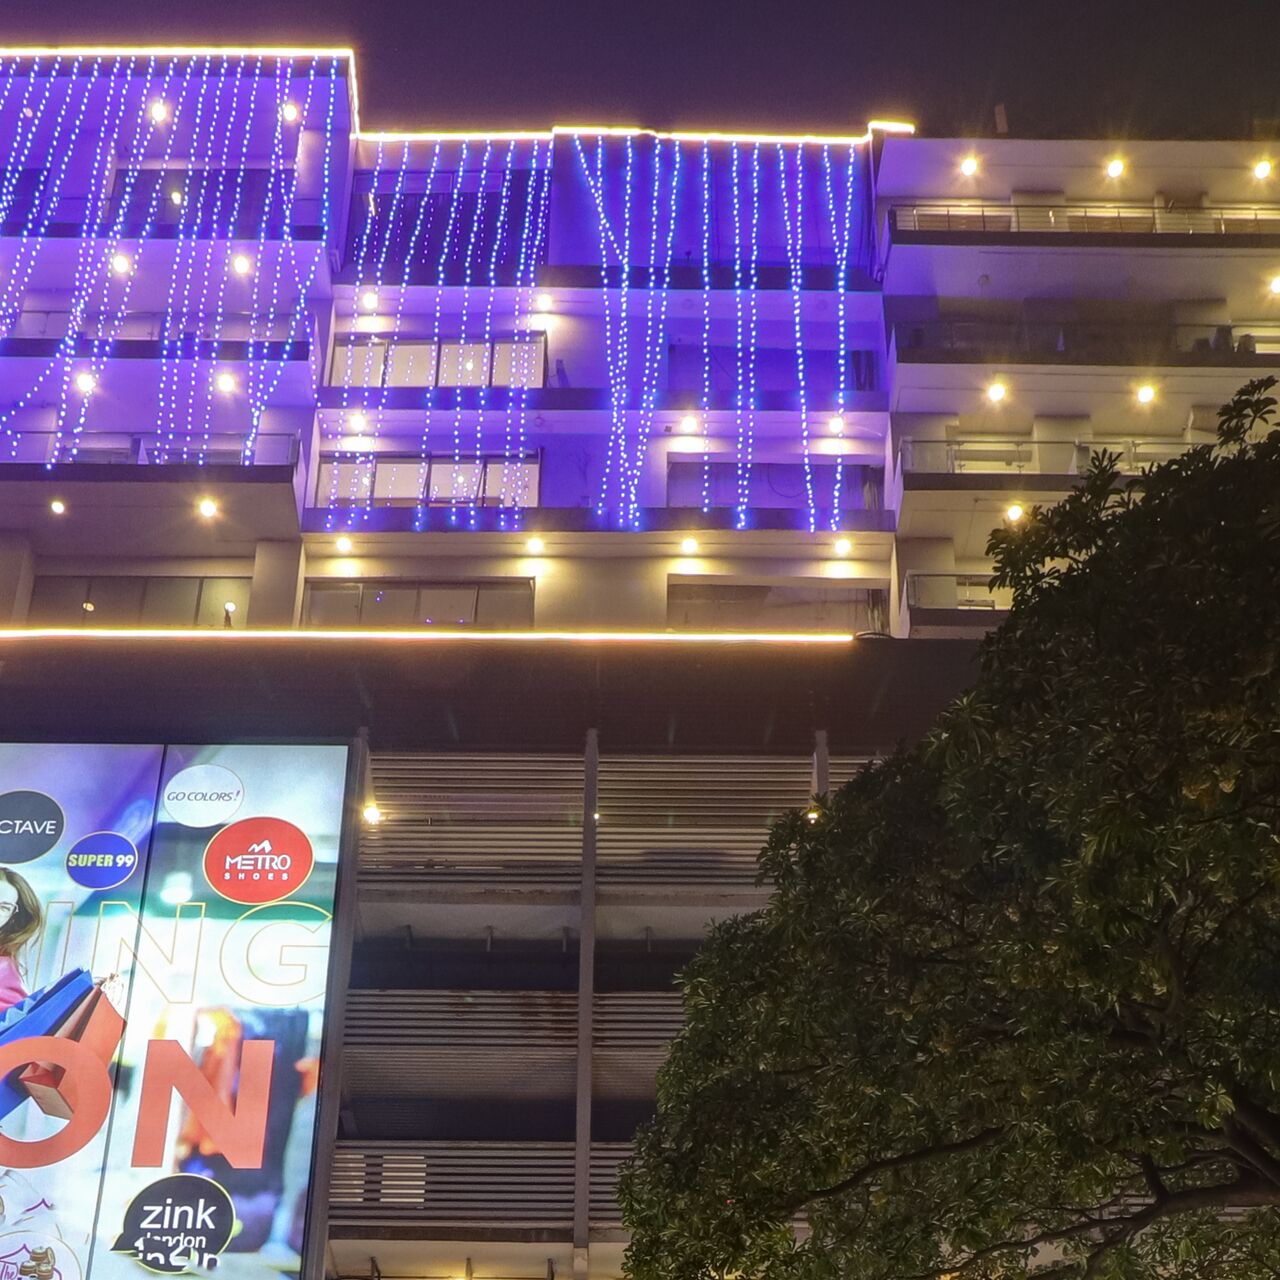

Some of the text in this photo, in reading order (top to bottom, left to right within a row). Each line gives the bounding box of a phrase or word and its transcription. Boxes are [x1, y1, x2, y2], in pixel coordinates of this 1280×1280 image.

[167, 791, 186, 802] GO
[68, 854, 135, 868] SUPER 99
[224, 854, 291, 871] METRO
[223, 872, 289, 881] SHOES
[139, 1198, 217, 1229] zink
